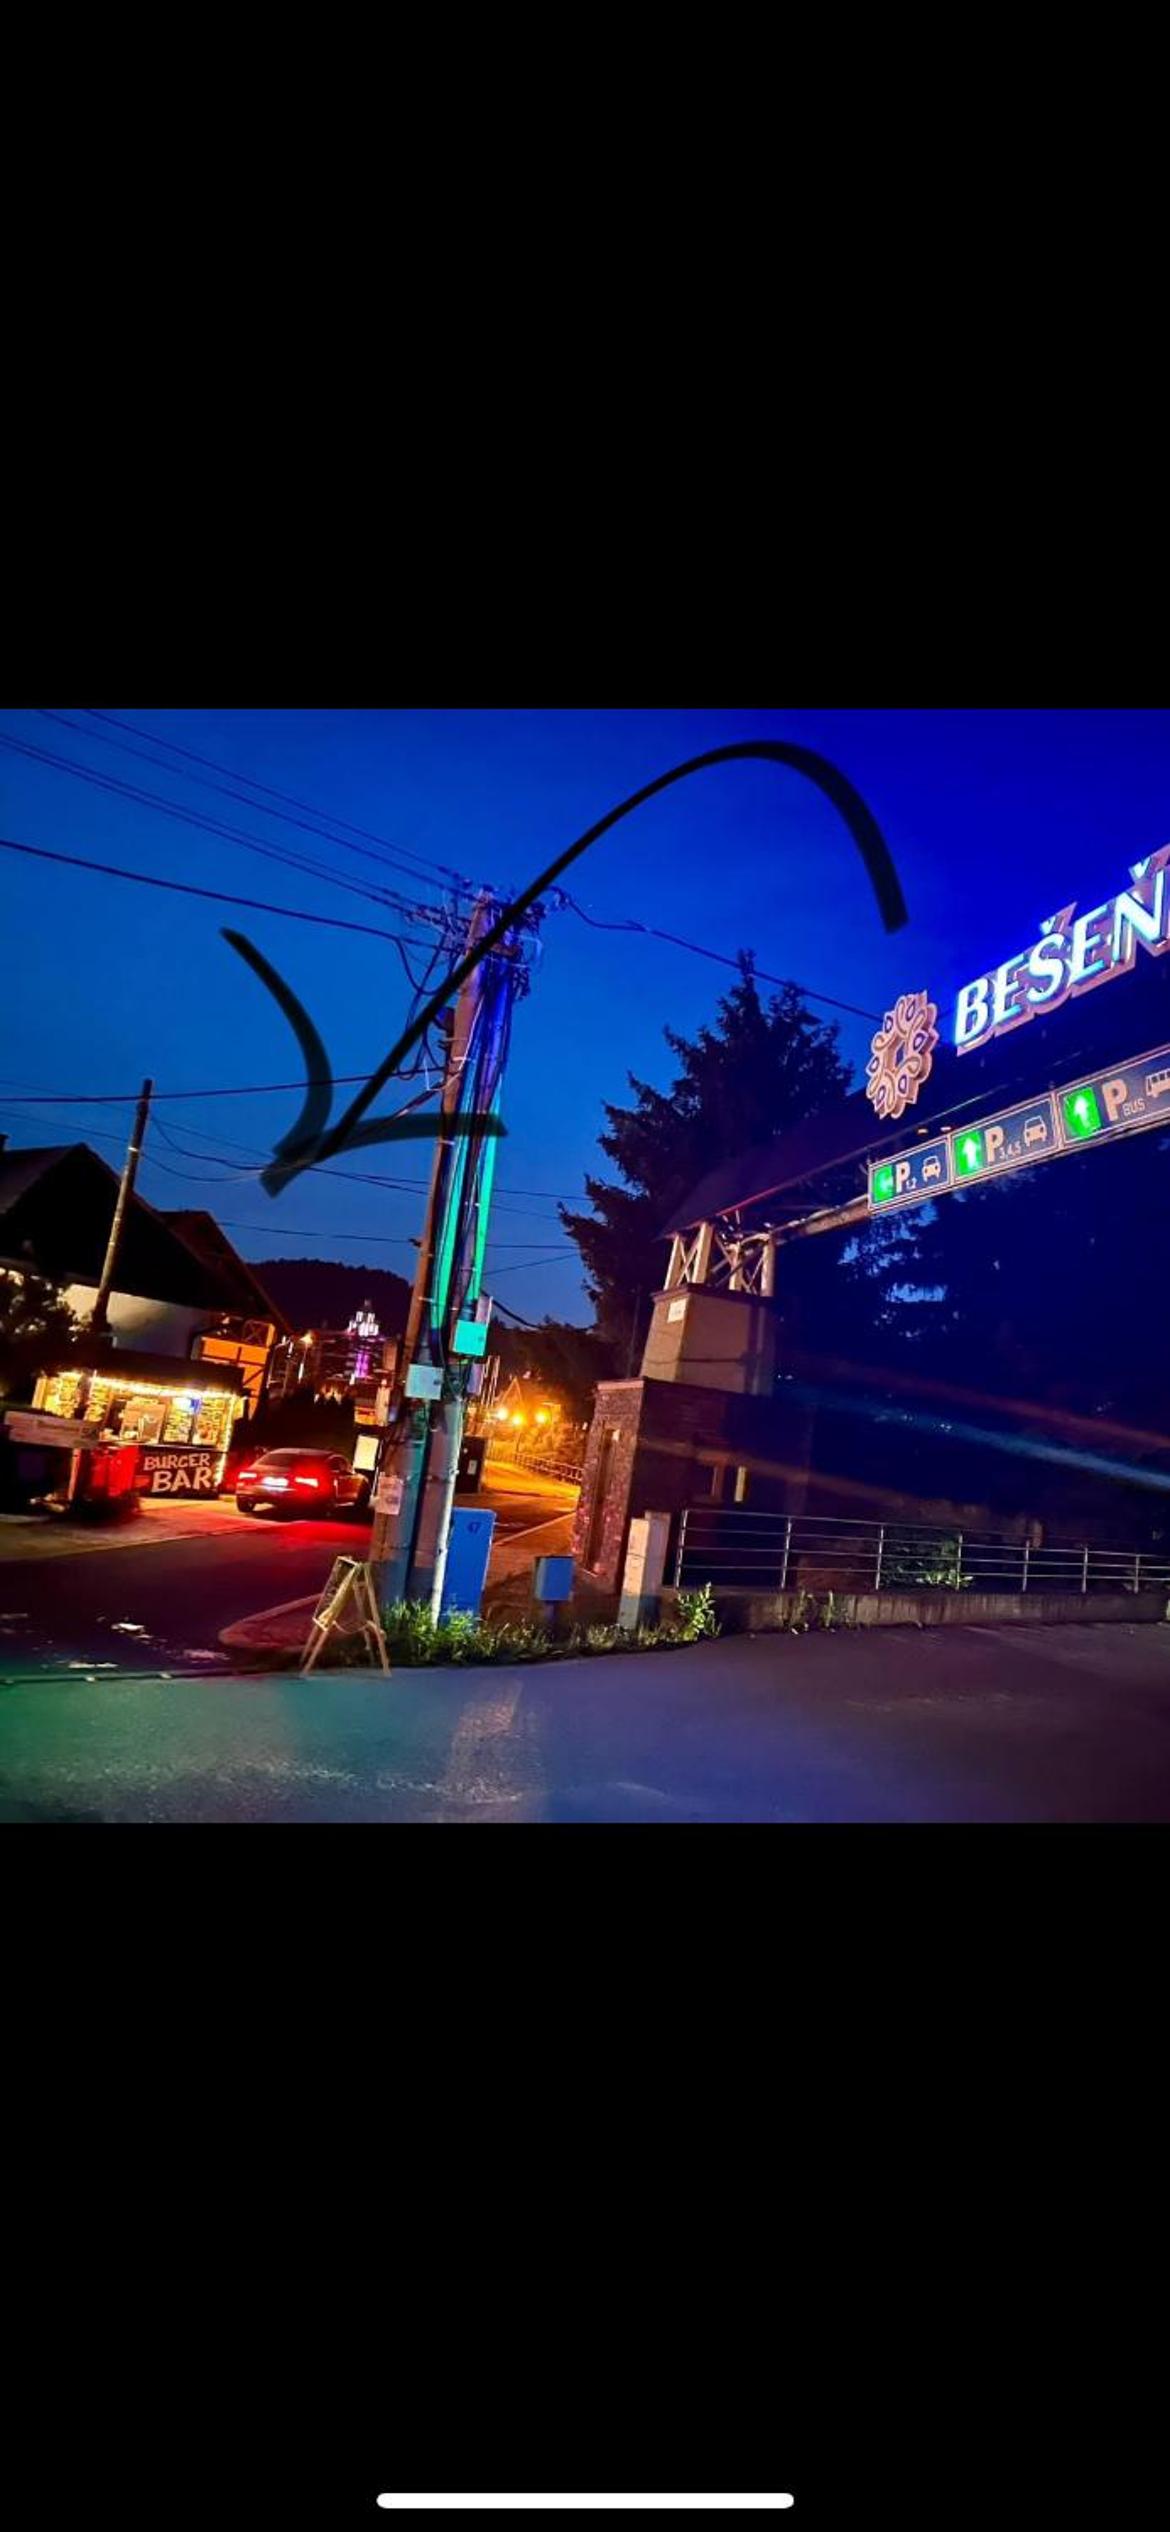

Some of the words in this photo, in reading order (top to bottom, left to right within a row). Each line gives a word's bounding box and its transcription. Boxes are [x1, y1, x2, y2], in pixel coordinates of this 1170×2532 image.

[1102, 1079, 1128, 1121] P
[1122, 1098, 1146, 1117] BUS
[984, 1125, 1004, 1163] P
[895, 1161, 911, 1193] P
[143, 1453, 211, 1471] BURGER
[151, 1467, 212, 1493] BAR
